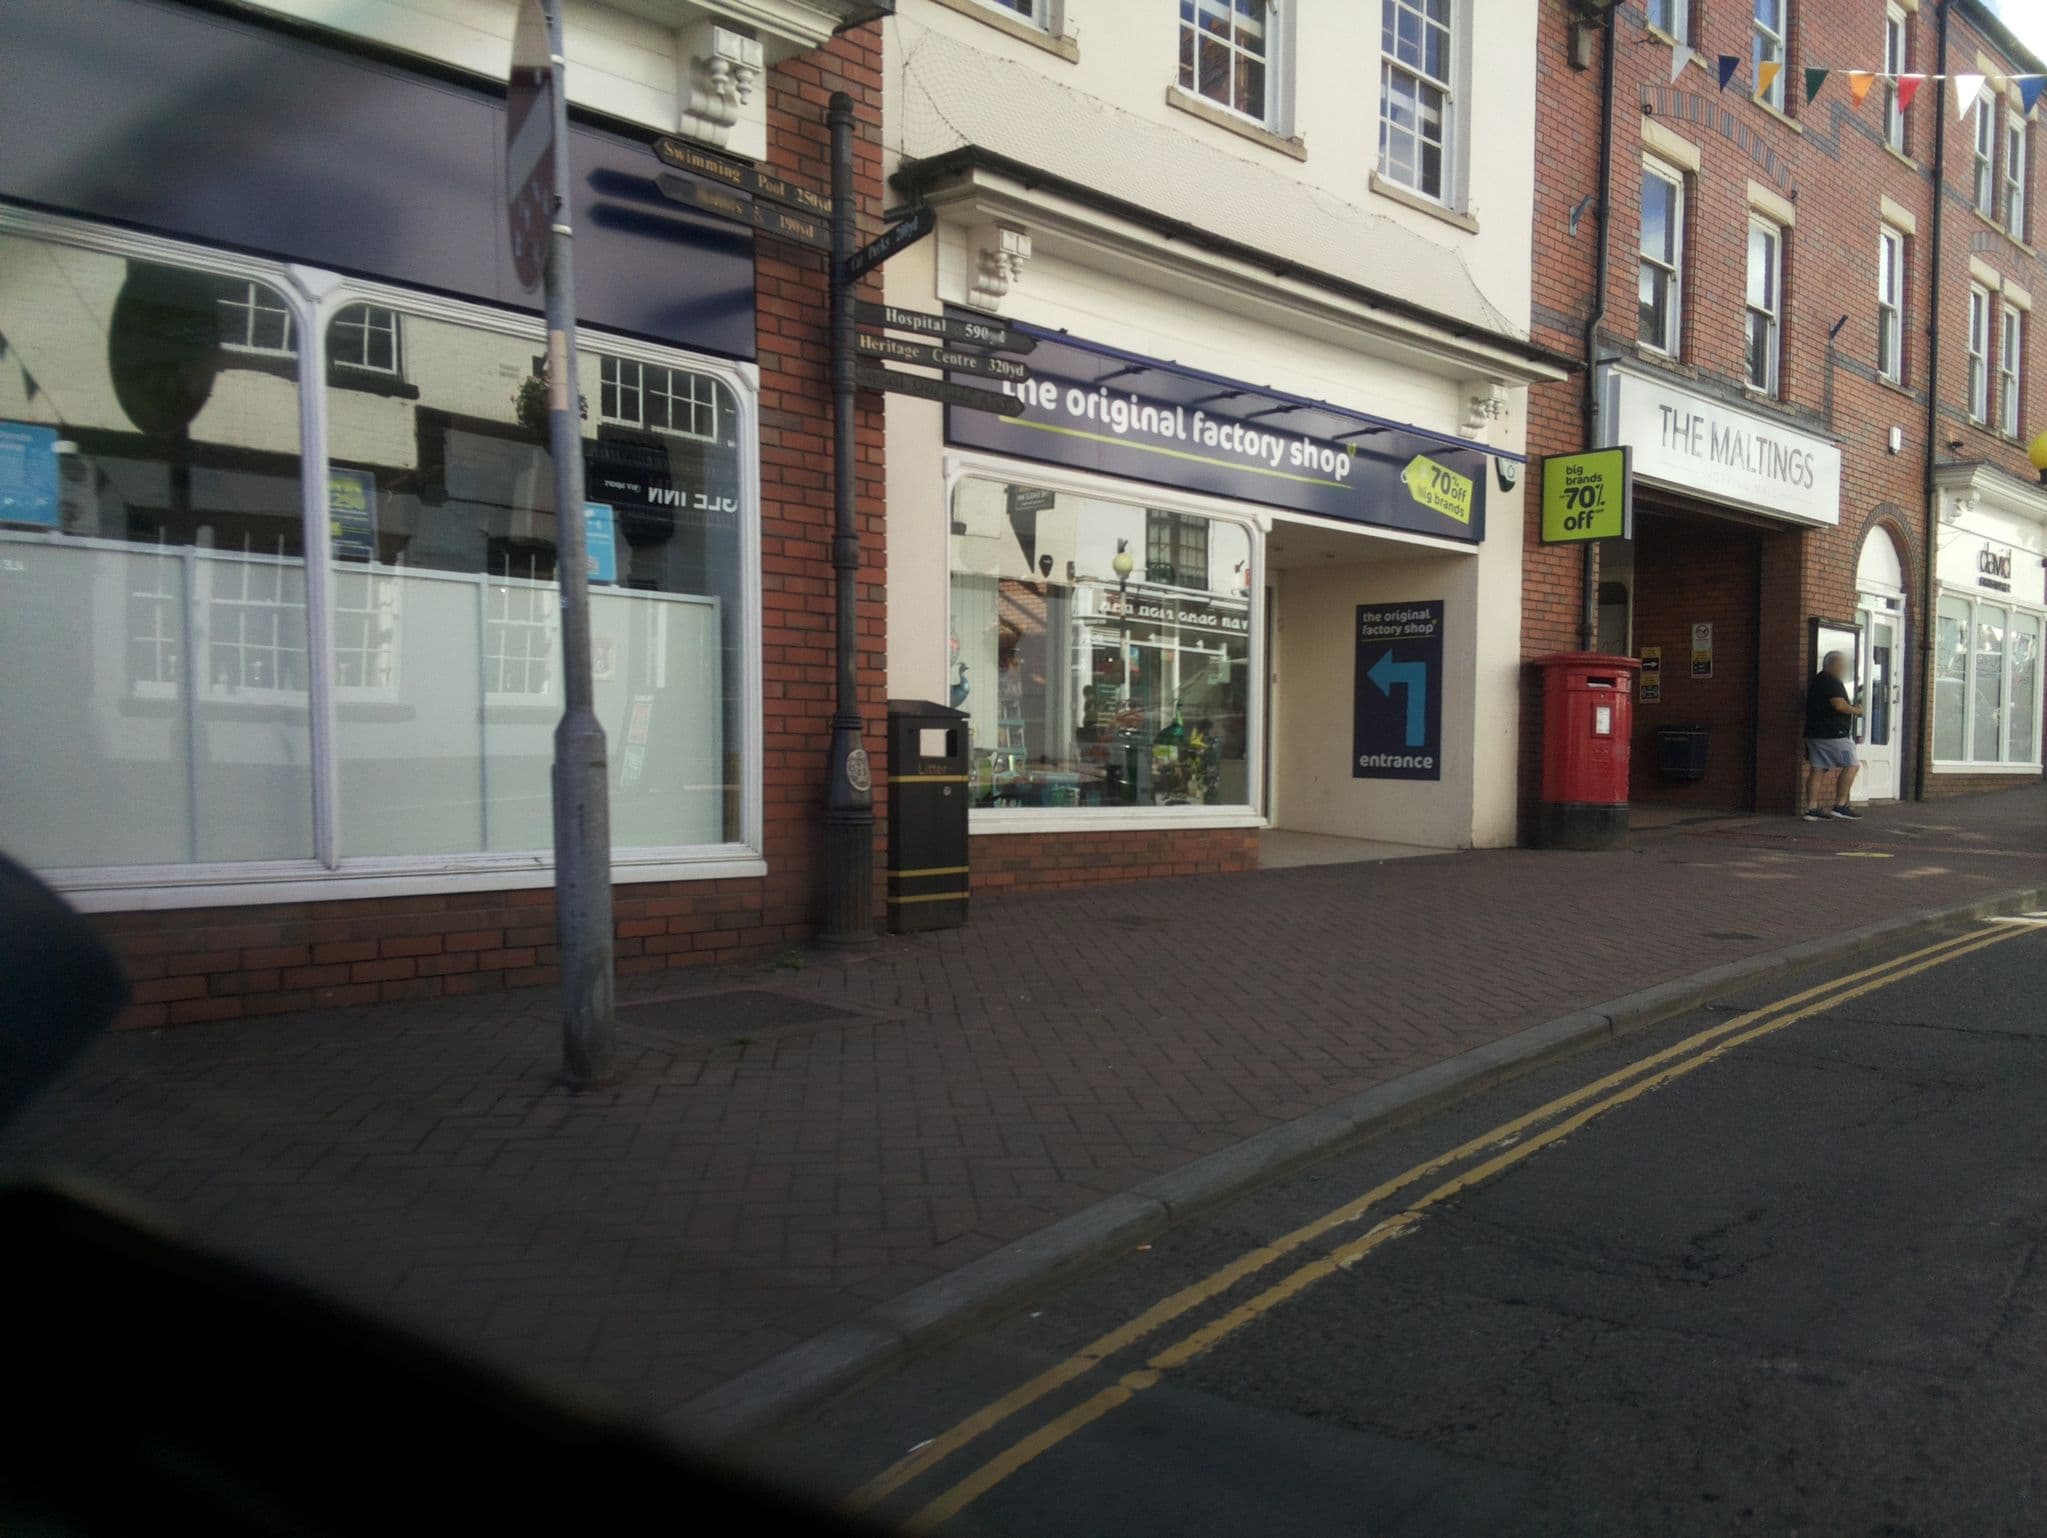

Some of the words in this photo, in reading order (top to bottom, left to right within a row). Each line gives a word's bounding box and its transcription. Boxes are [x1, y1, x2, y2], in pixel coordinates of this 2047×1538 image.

[664, 140, 741, 184] Swimming
[758, 173, 784, 196] Pool
[885, 308, 947, 332] Hospital
[860, 335, 920, 358] Heritage
[932, 349, 977, 368] Centre
[988, 358, 1024, 378] 320yd
[1066, 386, 1187, 441] original
[1193, 410, 1285, 467] factory
[1290, 437, 1350, 481] shop
[1659, 403, 1704, 458] THE
[1710, 421, 1814, 490] MALTINGS
[1566, 465, 1583, 475] big
[1566, 472, 1603, 486] brands
[1434, 493, 1465, 517] brands
[1451, 487, 1468, 503] off
[1563, 484, 1606, 510] 70%
[1563, 510, 1595, 531] off
[1362, 611, 1382, 623] the
[1384, 608, 1431, 623] original
[1362, 624, 1402, 636] factory
[1404, 622, 1434, 635] shop
[1359, 753, 1434, 769] entrance
